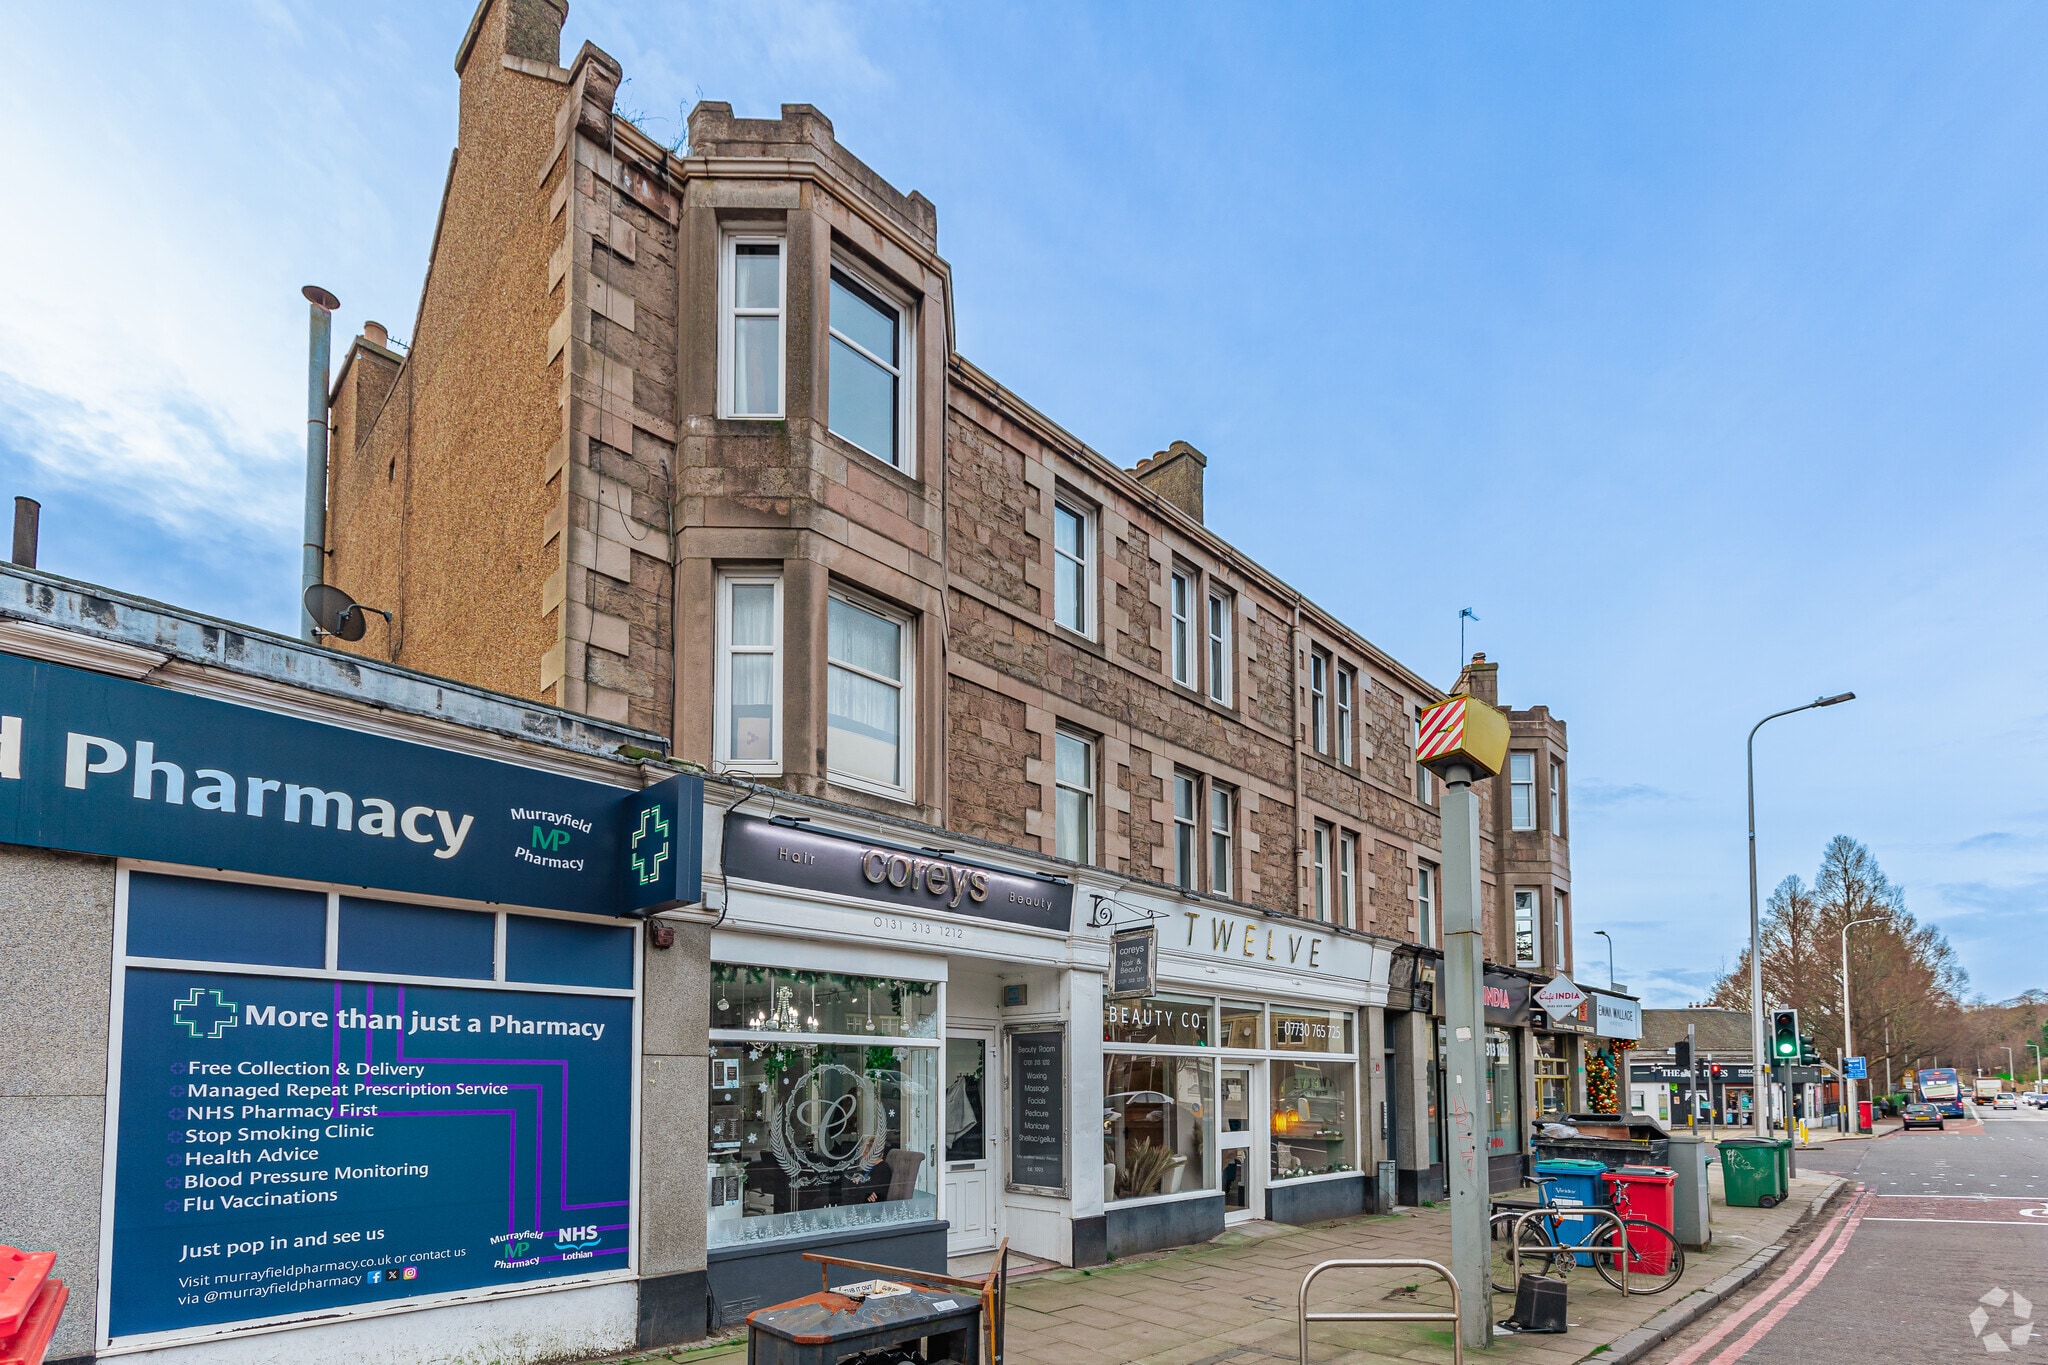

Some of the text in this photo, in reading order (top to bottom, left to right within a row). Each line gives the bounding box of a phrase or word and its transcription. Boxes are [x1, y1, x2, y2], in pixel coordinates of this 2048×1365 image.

[64, 731, 474, 859] Pharmacy
[510, 807, 592, 834] Murrayfield
[531, 825, 571, 852] MP
[514, 846, 584, 871] Pharmacy
[778, 847, 815, 865] Hair
[862, 849, 990, 908] coreys
[1009, 891, 1053, 911] Beauty
[873, 916, 963, 939] 0131 313 1212
[1184, 911, 1322, 968] TWELVE
[1119, 945, 1145, 956] coreys
[1120, 966, 1143, 974] Beauty
[1555, 992, 1580, 1000] INDIA
[245, 1004, 605, 1041] More than just a Pharmacy
[1109, 1006, 1206, 1031] BEAUTY CO.
[1612, 1007, 1633, 1021] WALLACE
[1284, 1021, 1341, 1040] 07730 765 725
[1018, 1045, 1056, 1054] Beauty Room
[188, 1060, 425, 1079] Free Collection & Delivery
[1026, 1072, 1047, 1081] Waxing
[1660, 1069, 1681, 1077] THE
[188, 1083, 509, 1100] Managed Repeat Prescription Service
[1024, 1084, 1049, 1093] Massage
[1027, 1097, 1046, 1105] Facials
[187, 1103, 378, 1120] NHS Pharmacy First
[1025, 1109, 1049, 1118] Pedicure
[185, 1123, 375, 1145] Stop Smoking Clinic
[1024, 1121, 1050, 1130] Manicure
[185, 1146, 319, 1166] Health Advice
[184, 1162, 429, 1189] Blood Pressure Monitoring
[183, 1189, 338, 1212] Flu Vaccinations
[489, 1230, 544, 1245] Murrayfield
[558, 1224, 598, 1243] NHS
[179, 1229, 386, 1263] Just pop in and see us
[504, 1241, 530, 1259] MP
[562, 1250, 593, 1261] Lothian
[178, 1248, 467, 1289] Visit murrayfieldpharmacy.co.uk or contact us
[494, 1256, 540, 1269] Pharmacy
[178, 1292, 199, 1306] via
[203, 1274, 362, 1304] @murrayfieldpharmacy
